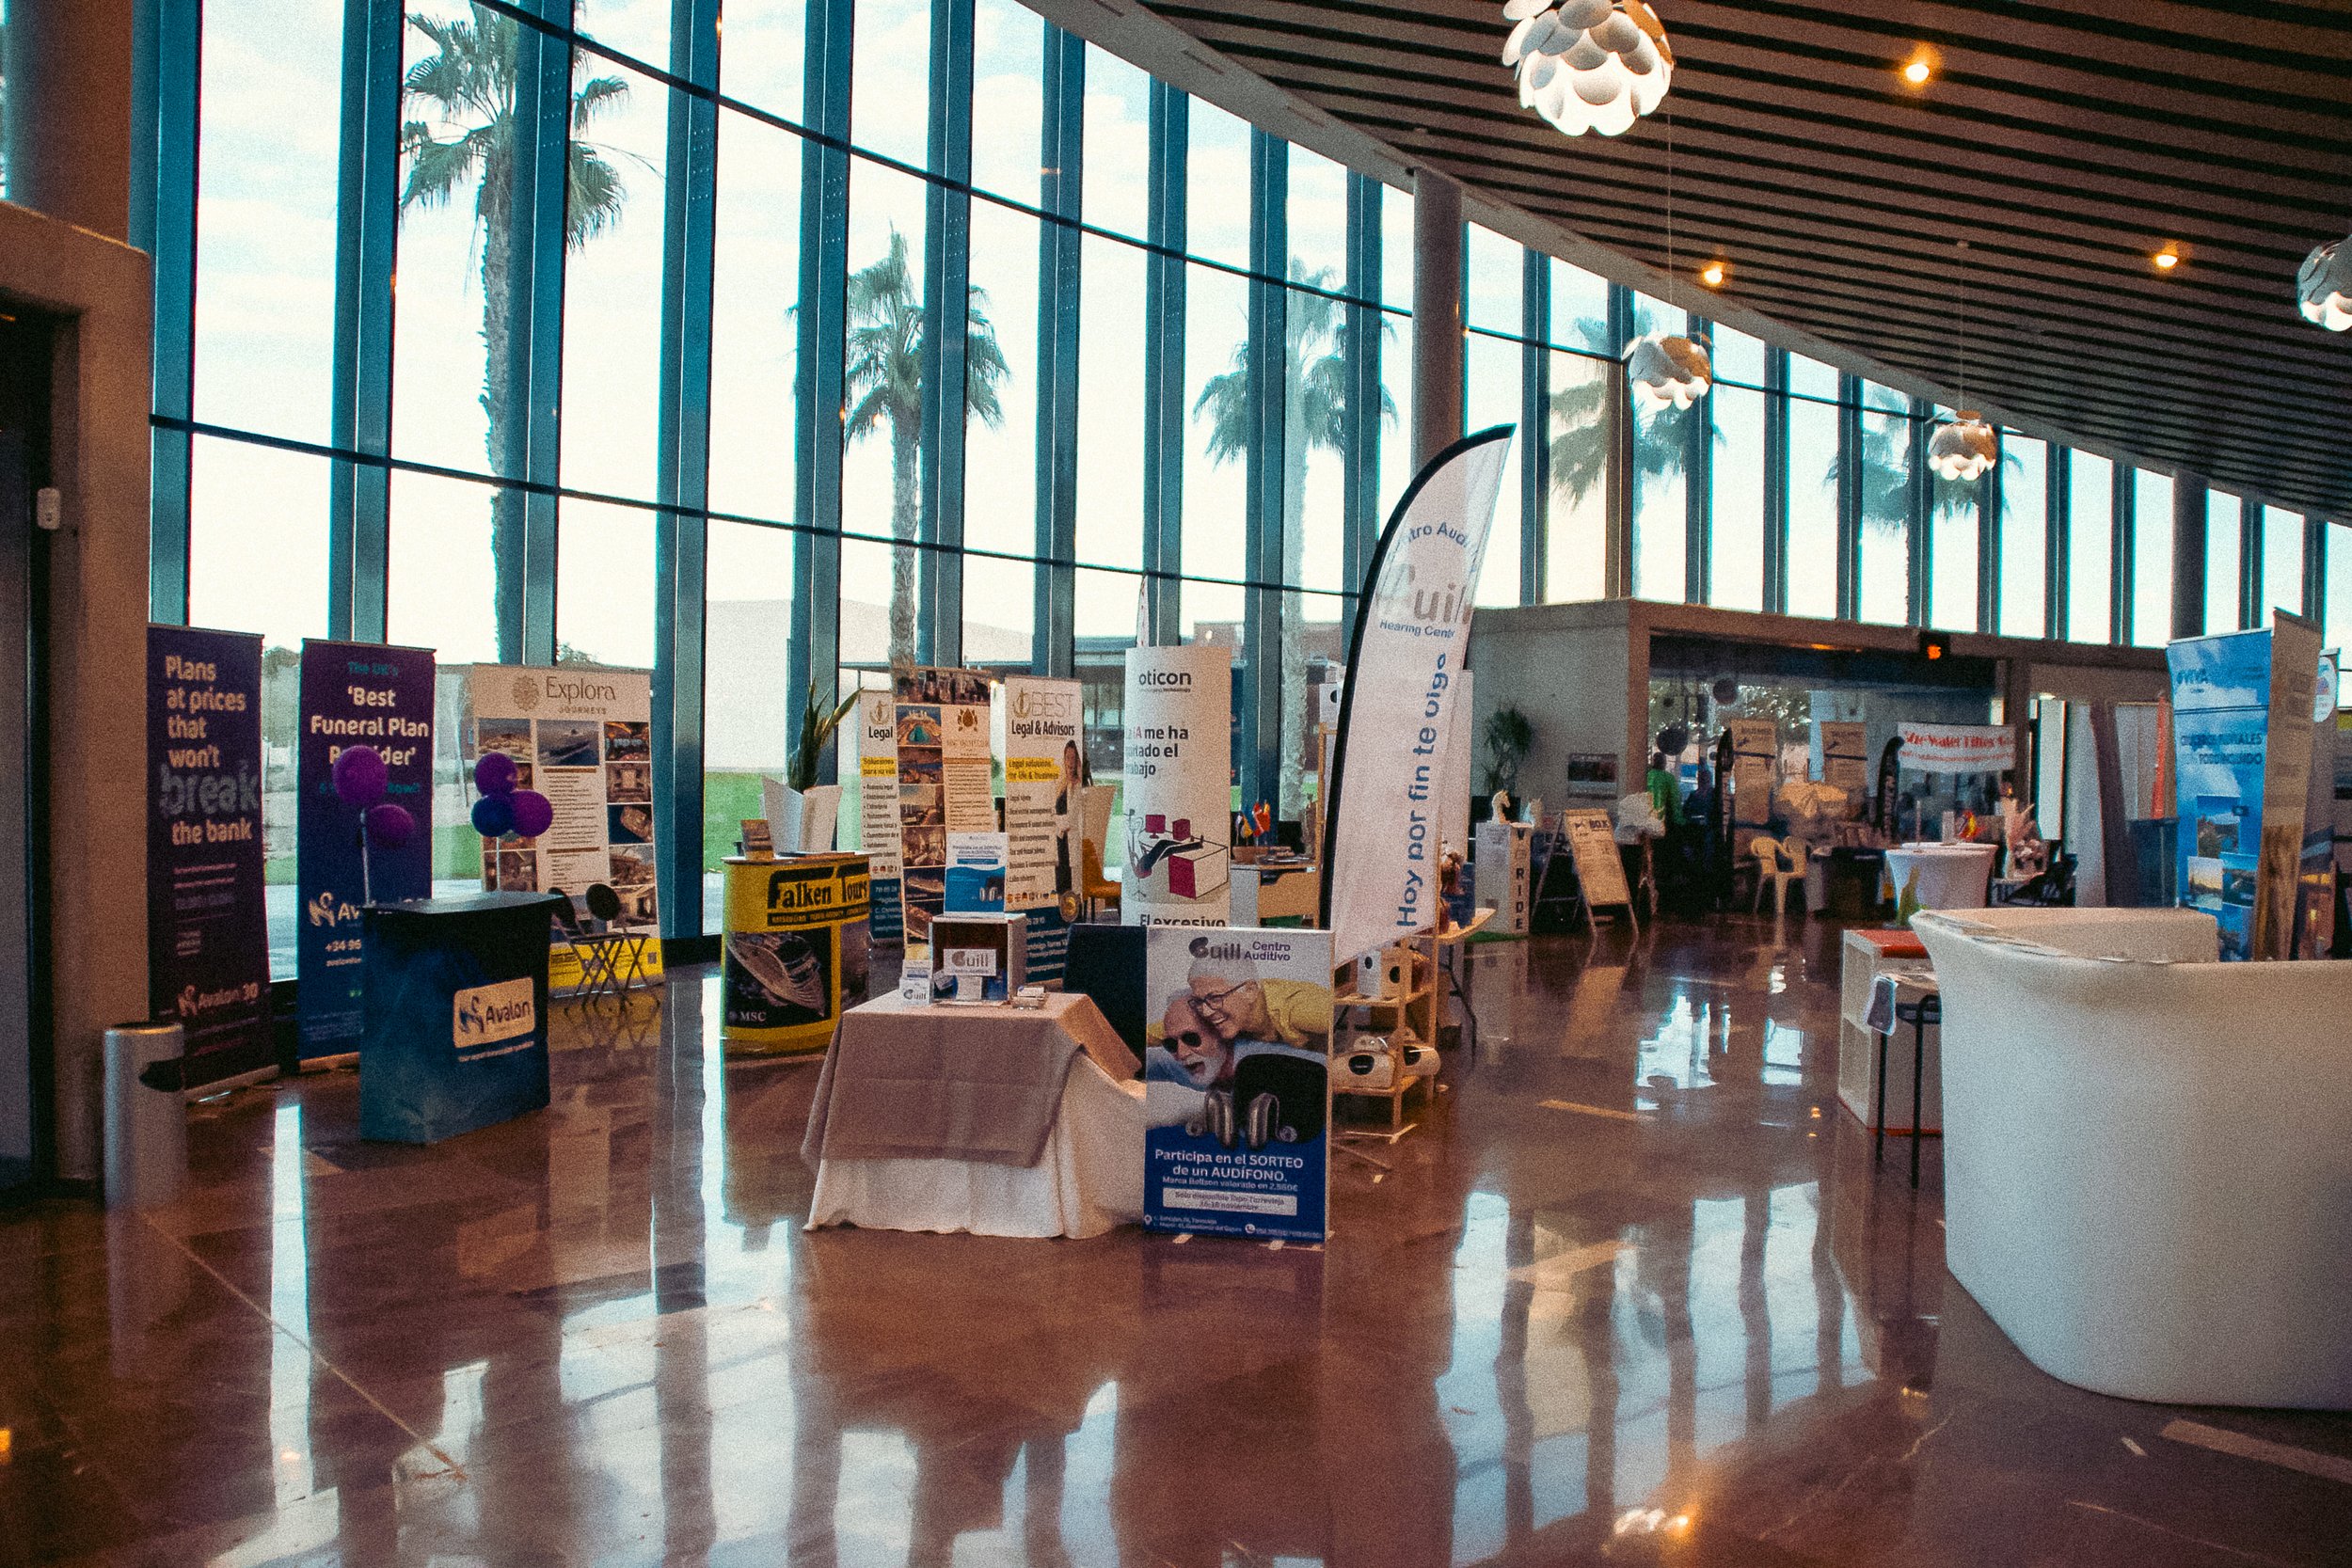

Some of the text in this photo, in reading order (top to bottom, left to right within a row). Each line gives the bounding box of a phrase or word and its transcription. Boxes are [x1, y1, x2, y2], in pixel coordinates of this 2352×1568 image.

[1379, 620, 1422, 638] Hearing
[165, 656, 217, 682] Plans
[1138, 669, 1192, 686] oticon
[167, 686, 247, 713] at prices
[546, 675, 617, 703] Explora
[1031, 691, 1074, 717] BEST
[167, 715, 207, 739] that
[310, 715, 429, 737] Funeral Plan
[868, 725, 893, 741] Legal
[1011, 720, 1075, 738] Legal & Advisors
[1144, 729, 1165, 740] me
[1168, 725, 1189, 740] ha
[167, 744, 220, 768] won't
[1163, 743, 1179, 758] el
[158, 759, 260, 816] break
[1397, 653, 1449, 927] Hoy por fin te oigo
[171, 818, 253, 845] the bank
[768, 866, 834, 910] Falken
[1244, 951, 1292, 961] Auditivo
[1252, 941, 1292, 952] Centro
[485, 1000, 531, 1025] Avalon
[739, 1011, 767, 1022] MSC
[1155, 1148, 1304, 1169] Participa en el SORTEO
[1162, 1176, 1188, 1185] Marca
[1172, 1165, 1288, 1182] de un AUDÍFONO.
